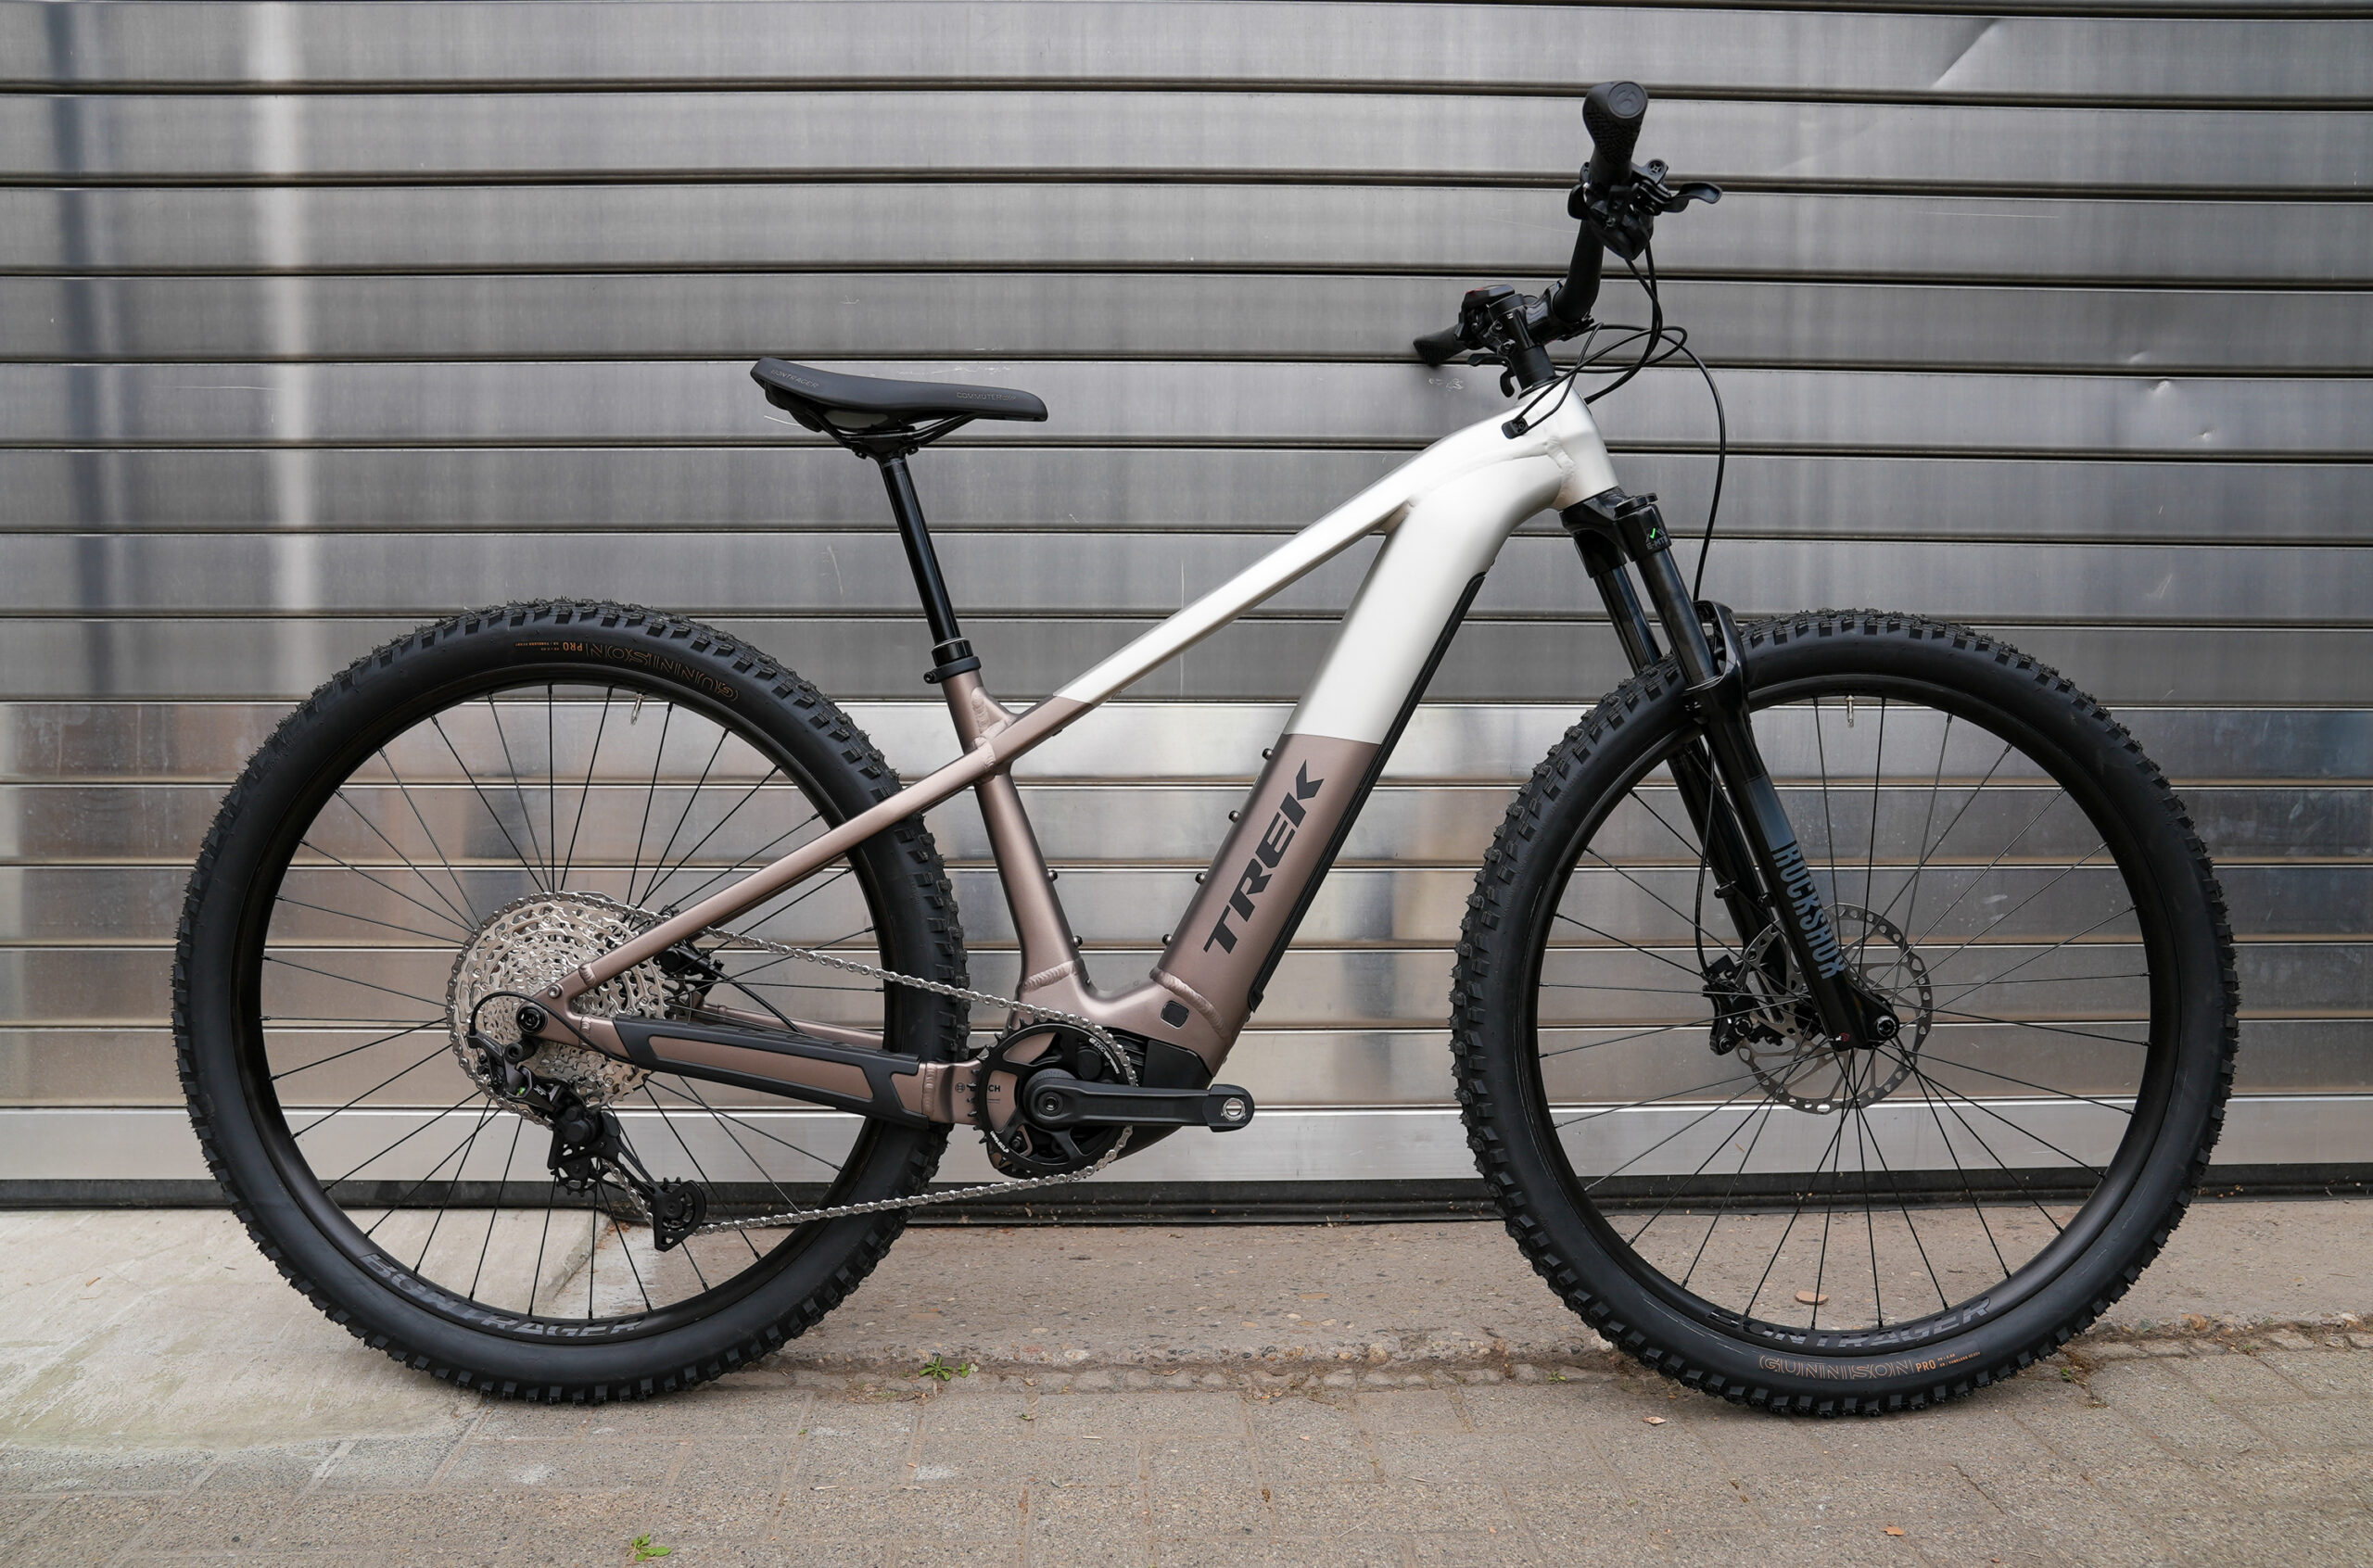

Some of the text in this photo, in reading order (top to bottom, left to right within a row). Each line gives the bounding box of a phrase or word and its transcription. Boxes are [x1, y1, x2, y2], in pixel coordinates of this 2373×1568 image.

[563, 641, 740, 702] GUNNISON PRO
[1202, 759, 1325, 955] TREK
[1771, 845, 1846, 980] ROCKSHOX
[360, 1253, 645, 1337] BONTRAGER
[1707, 1296, 1992, 1348] BONTRAGER
[1758, 1354, 1936, 1381] GUNNISON PRO
